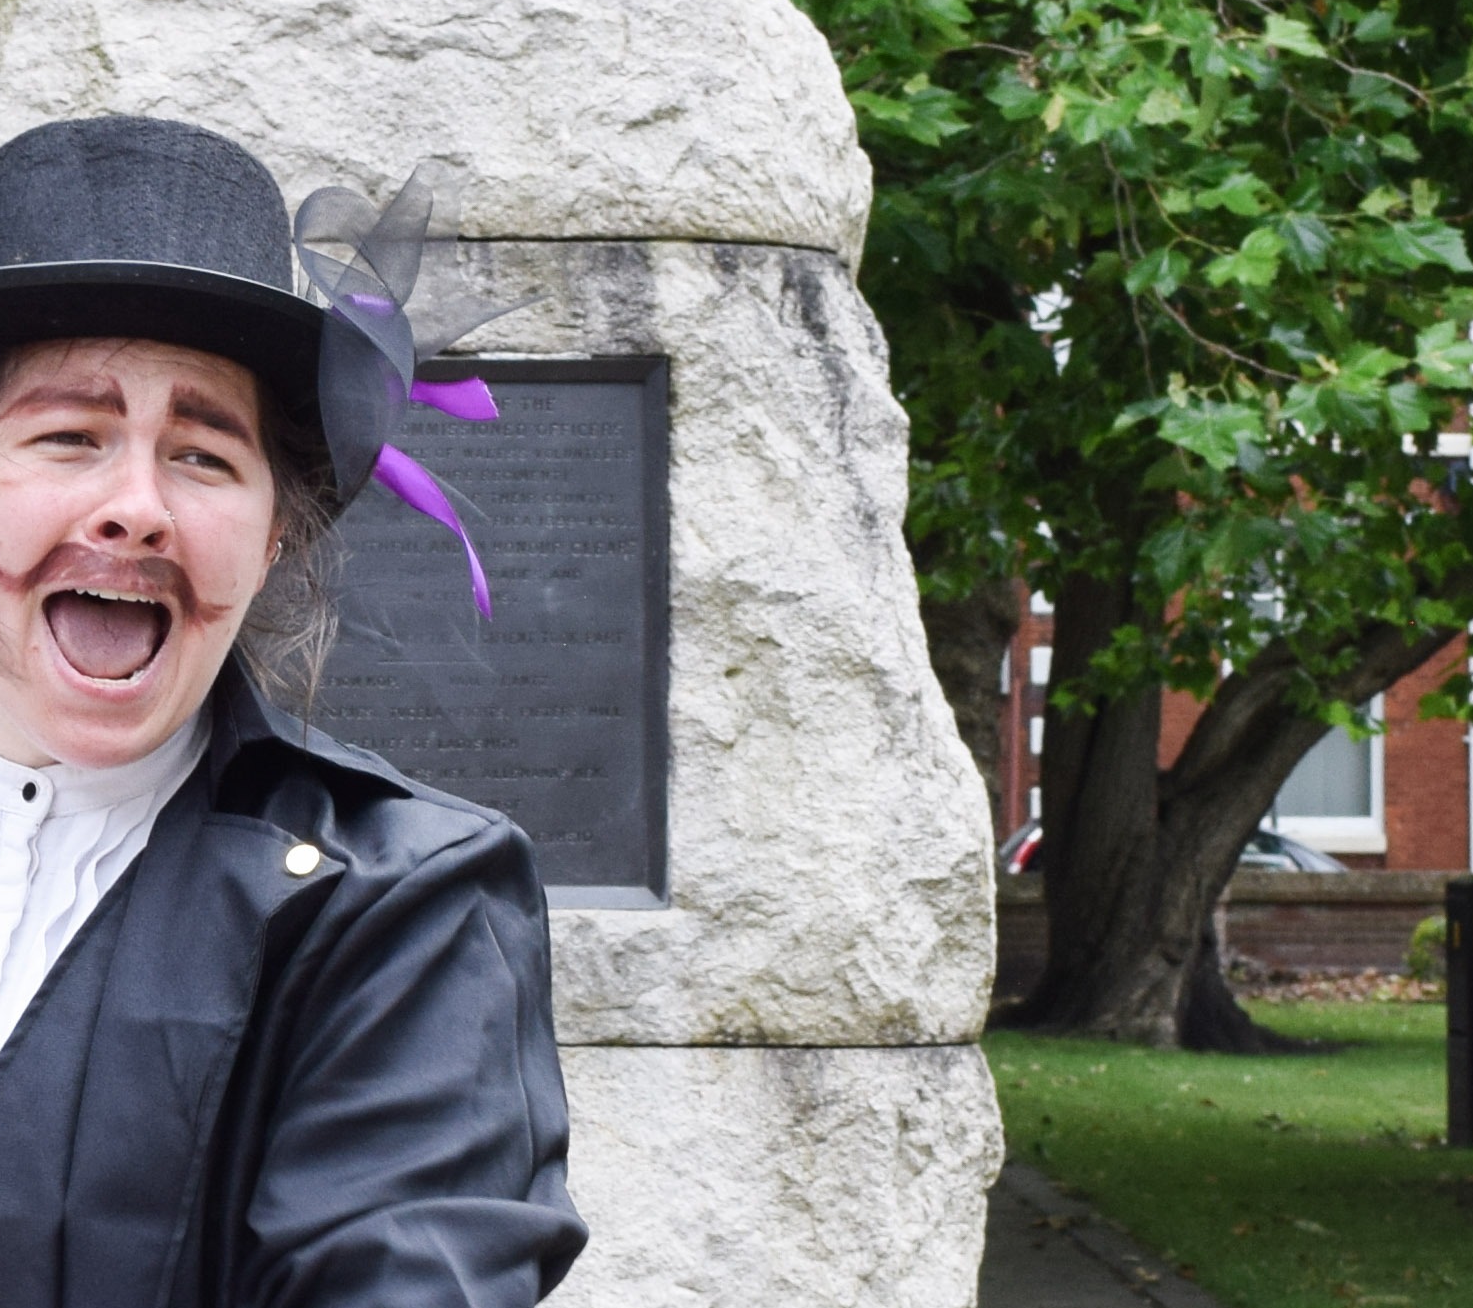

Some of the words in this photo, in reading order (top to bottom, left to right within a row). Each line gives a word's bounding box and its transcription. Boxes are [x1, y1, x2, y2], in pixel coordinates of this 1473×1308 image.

[520, 396, 556, 411] THE
[535, 421, 624, 439] OFFICERS
[433, 447, 454, 461] OF
